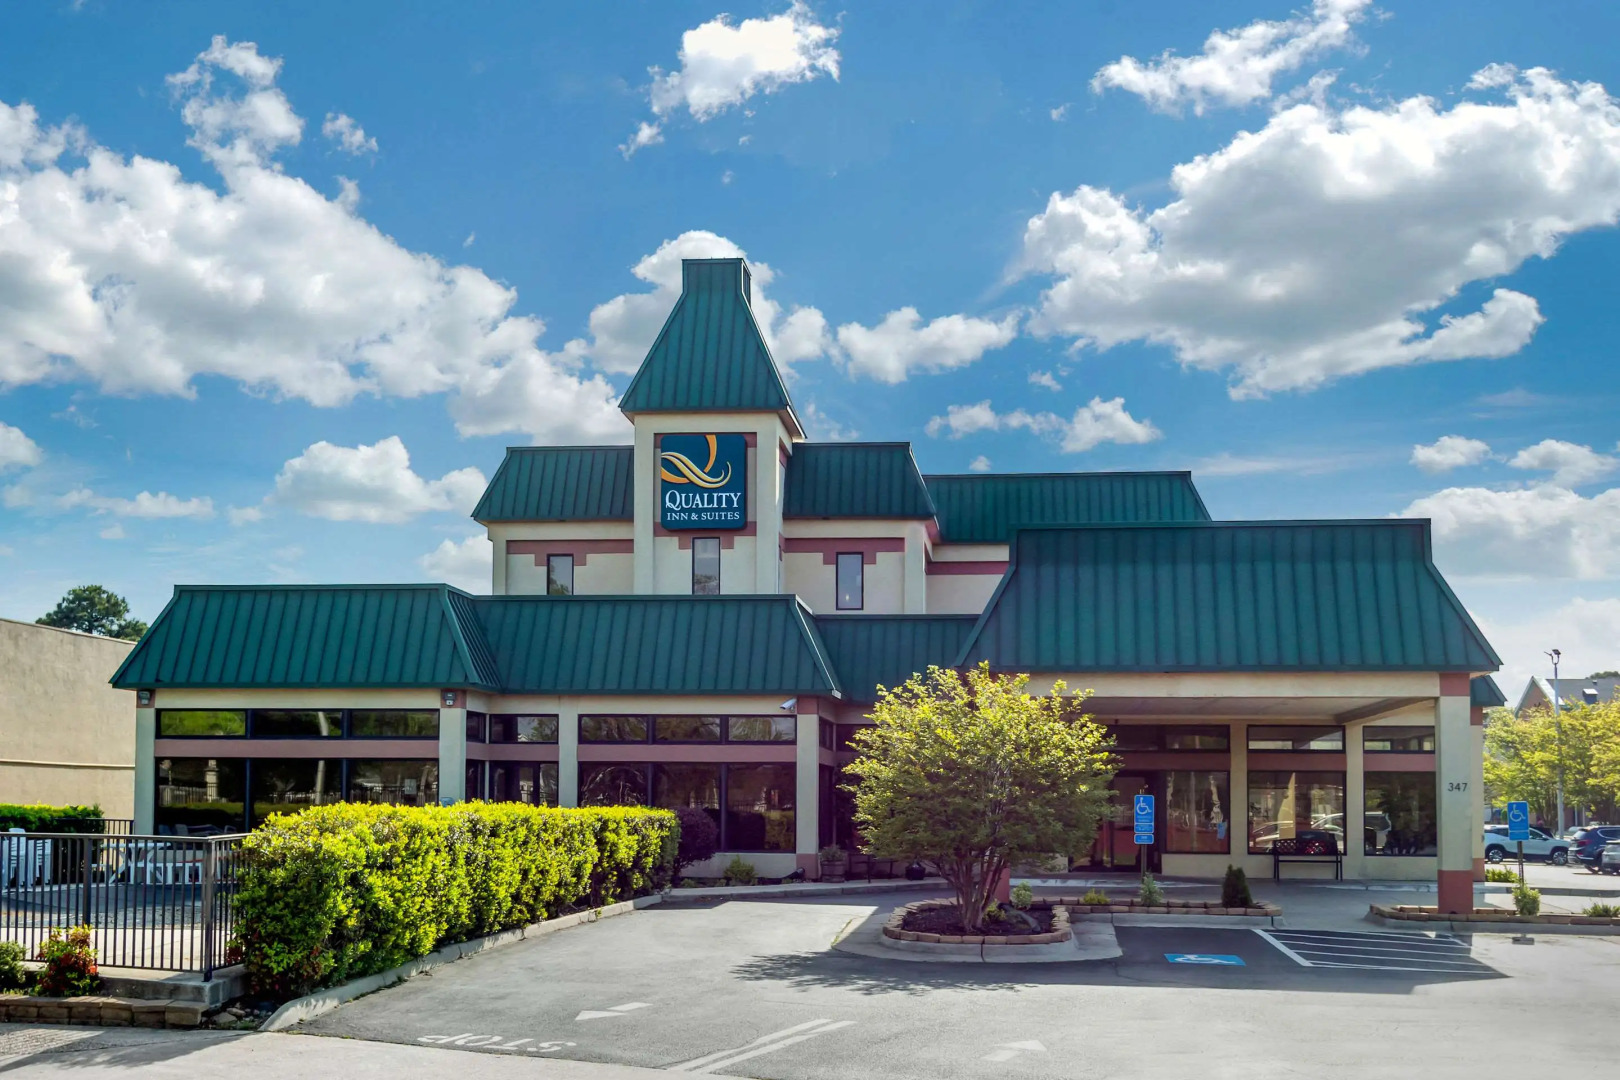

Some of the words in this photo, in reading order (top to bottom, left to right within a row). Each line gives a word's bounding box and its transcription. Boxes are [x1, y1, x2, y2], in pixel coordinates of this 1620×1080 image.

[665, 490, 741, 510] QUALITY
[666, 512, 688, 520] INN
[690, 512, 698, 520] &
[701, 511, 740, 520] SUITES
[1447, 782, 1468, 792] 347
[417, 1032, 577, 1052] STOP
